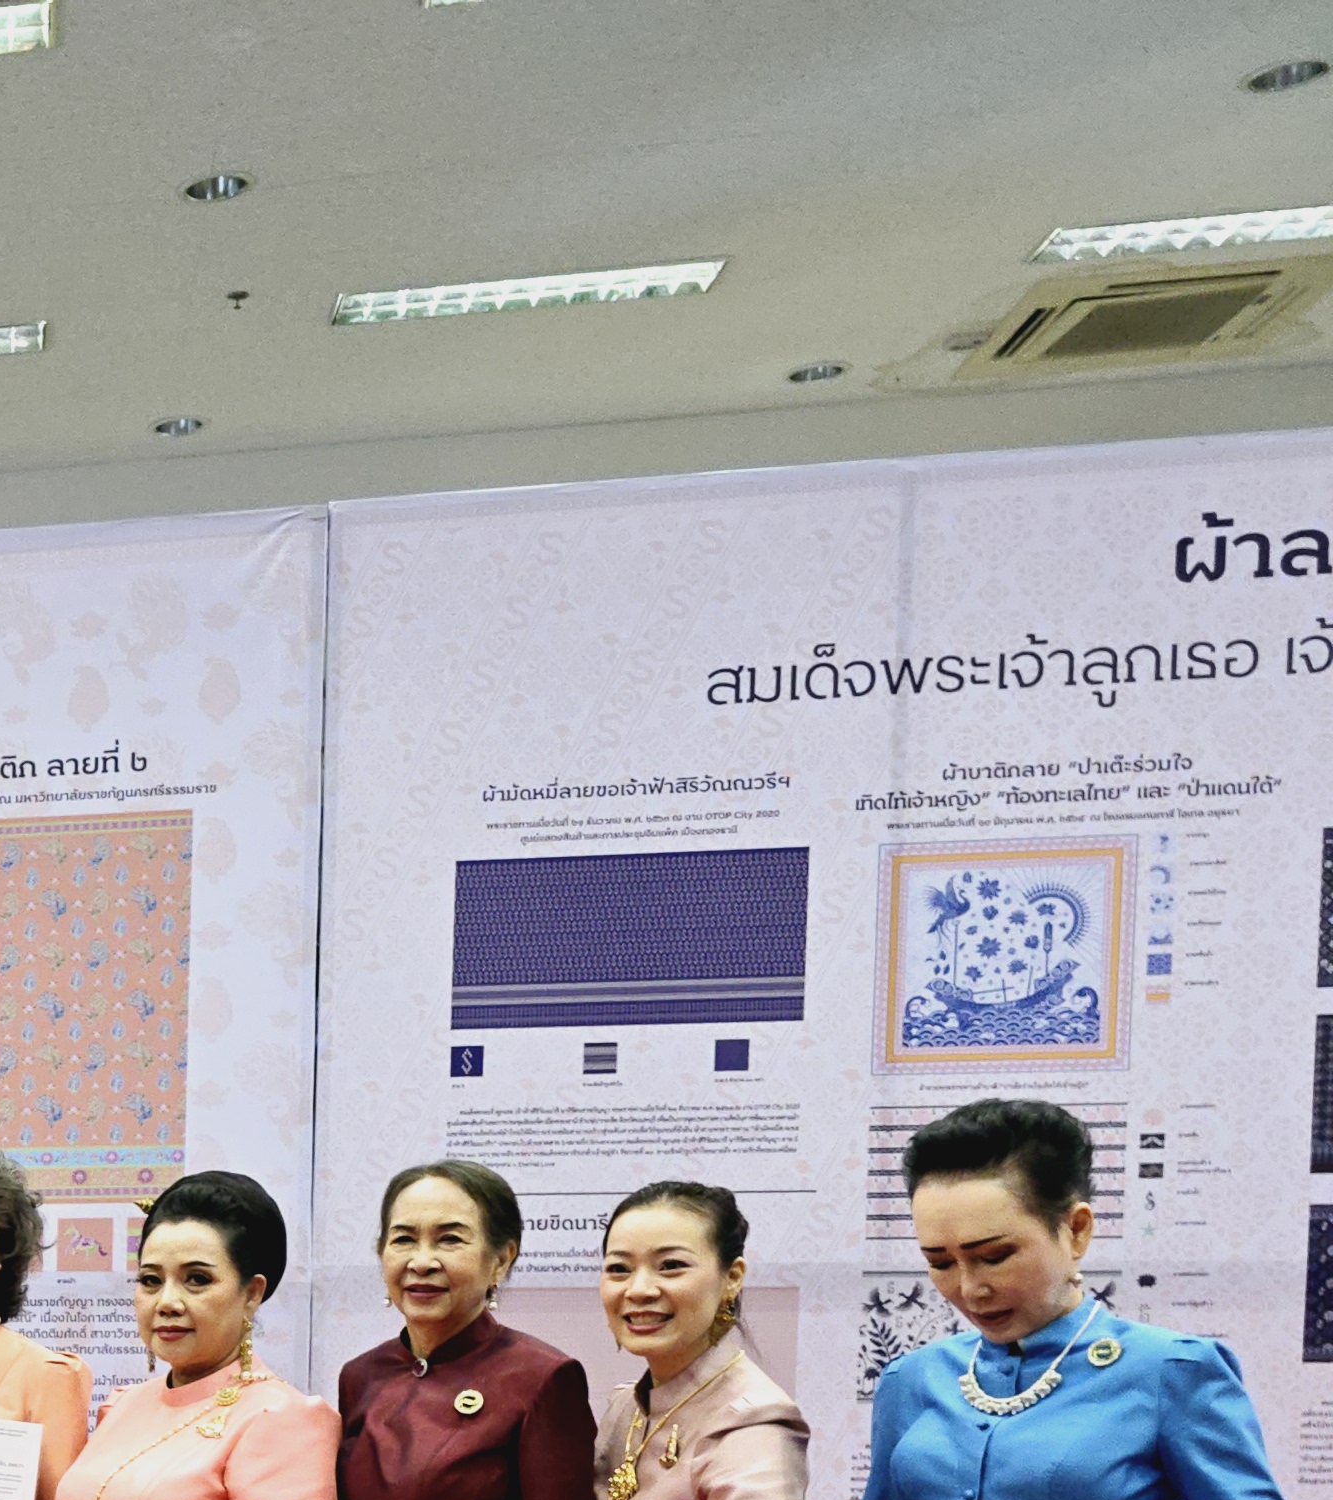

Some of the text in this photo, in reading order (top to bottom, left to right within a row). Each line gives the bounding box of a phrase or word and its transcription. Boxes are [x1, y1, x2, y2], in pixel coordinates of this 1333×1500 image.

[707, 633, 1259, 706] สมเด็จพระเจ้าลูกเธอ
[47, 742, 120, 777] ลายที่
[131, 752, 147, 772] ๒
[942, 762, 1060, 781] ผ้าบาติกลาย
[16, 783, 217, 803] มหาวิทยาลัยราชภัฏนครศรีธรรมราช
[483, 771, 790, 802] ผ้ามัดหมี่ลายขอเจ้าฟ้าสิริวัณณวรีฯ
[1137, 786, 1171, 799] และ
